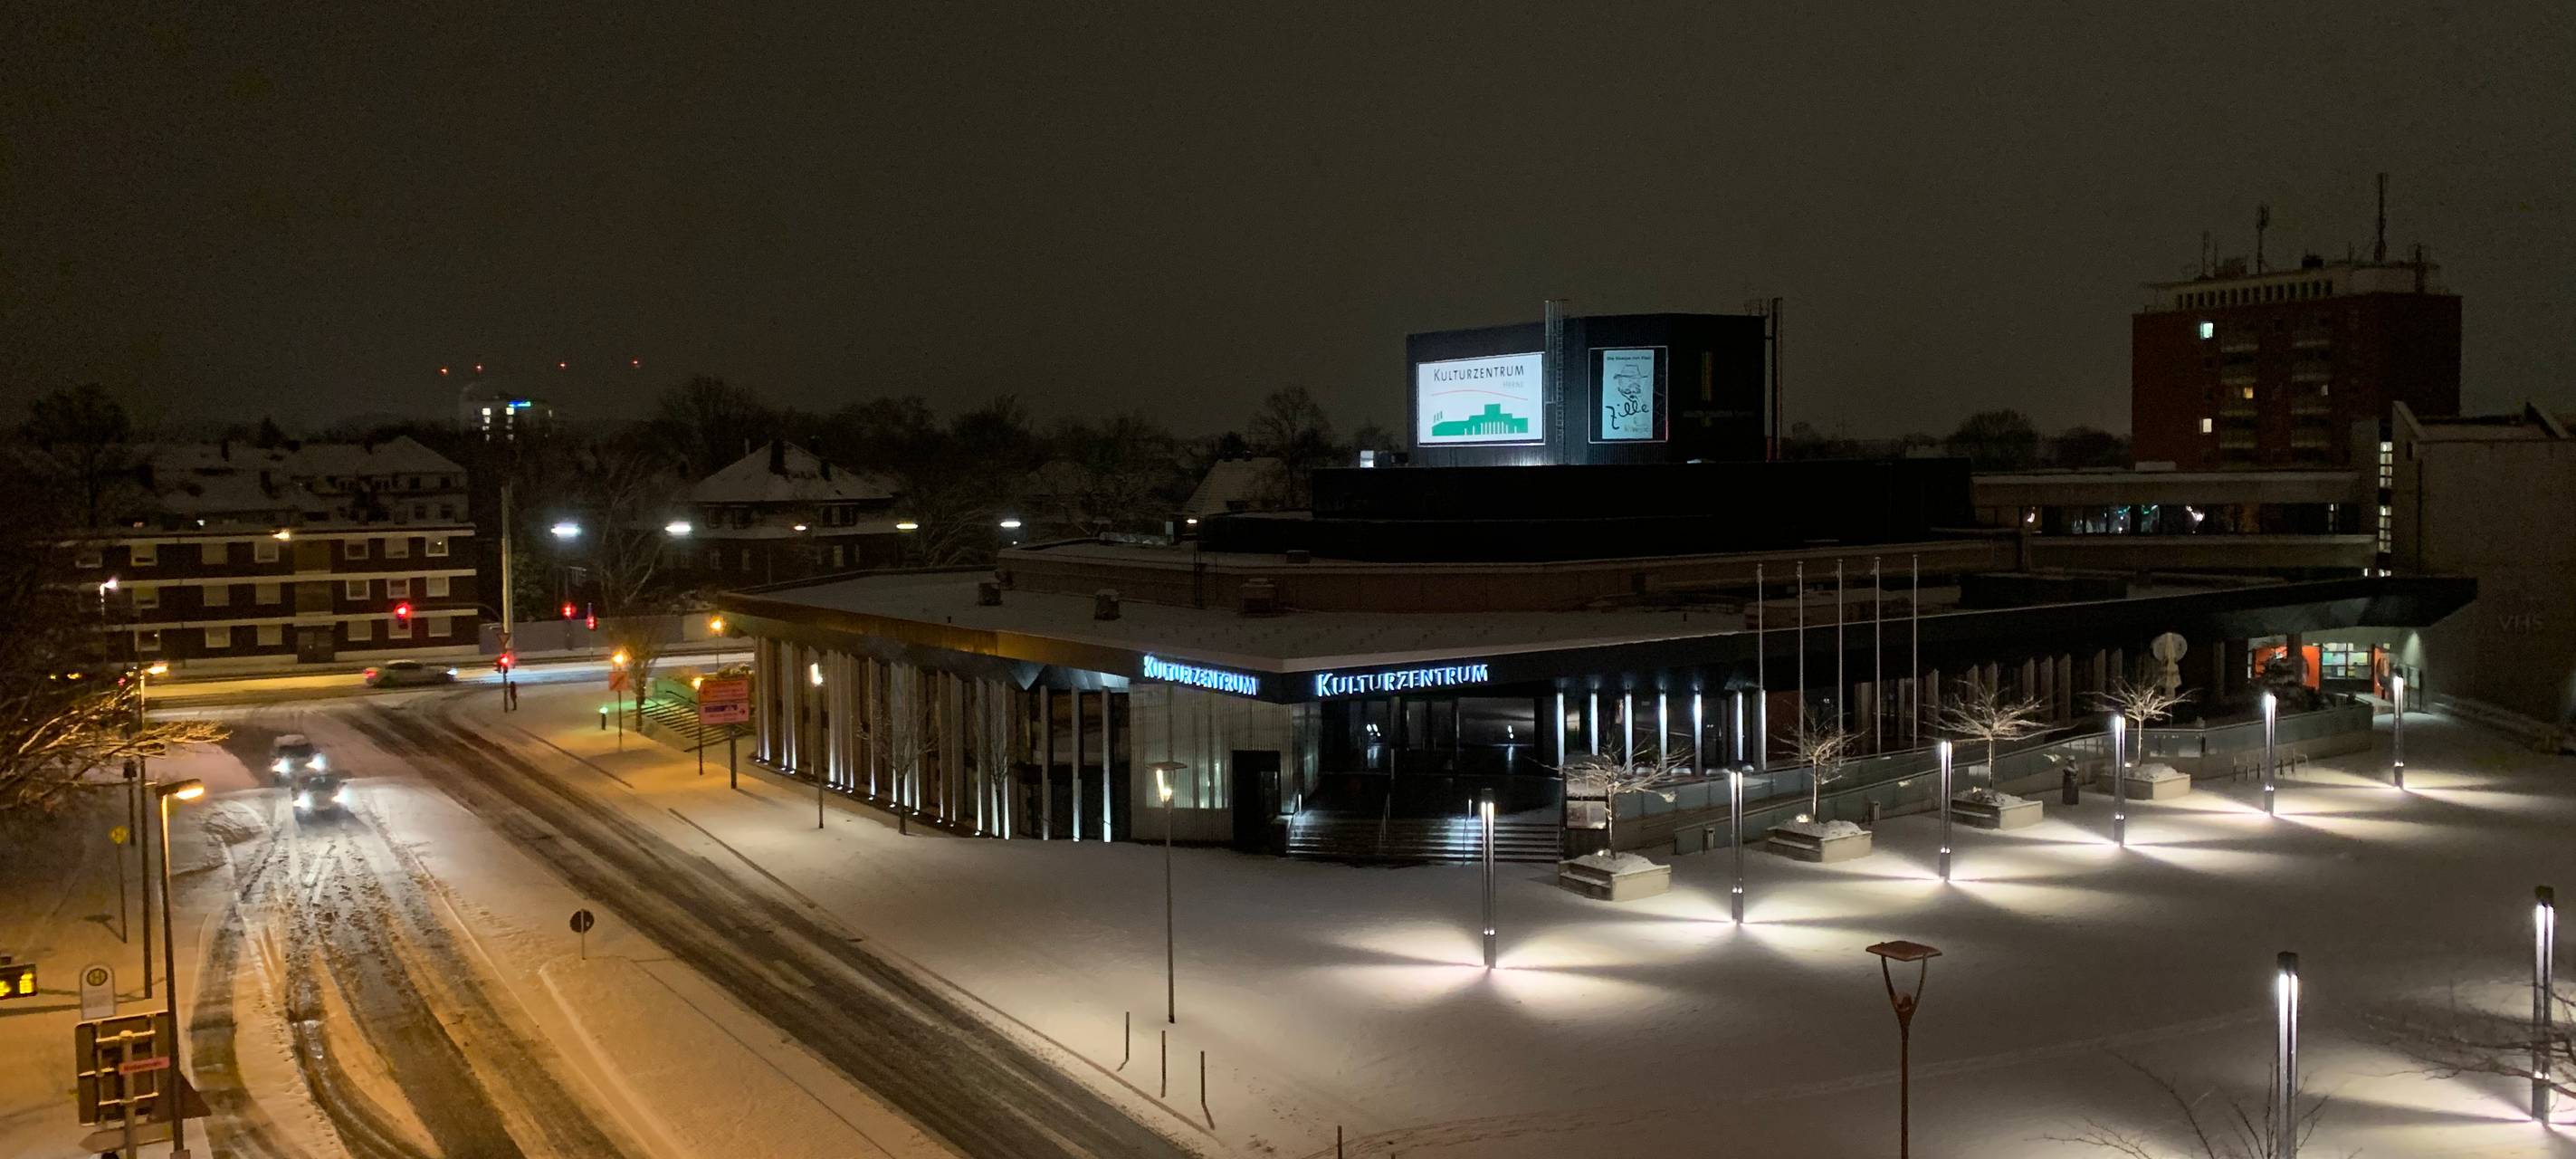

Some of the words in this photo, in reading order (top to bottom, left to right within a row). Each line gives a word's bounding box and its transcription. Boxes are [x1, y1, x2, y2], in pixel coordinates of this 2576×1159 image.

[1434, 365, 1524, 381] KULTURZENTRUM
[1605, 400, 1649, 430] Zille
[2497, 615, 2544, 631] VHS
[1143, 653, 1257, 695] KULTURZENTRUM
[1317, 664, 1489, 696] KULTURZENTRUM
